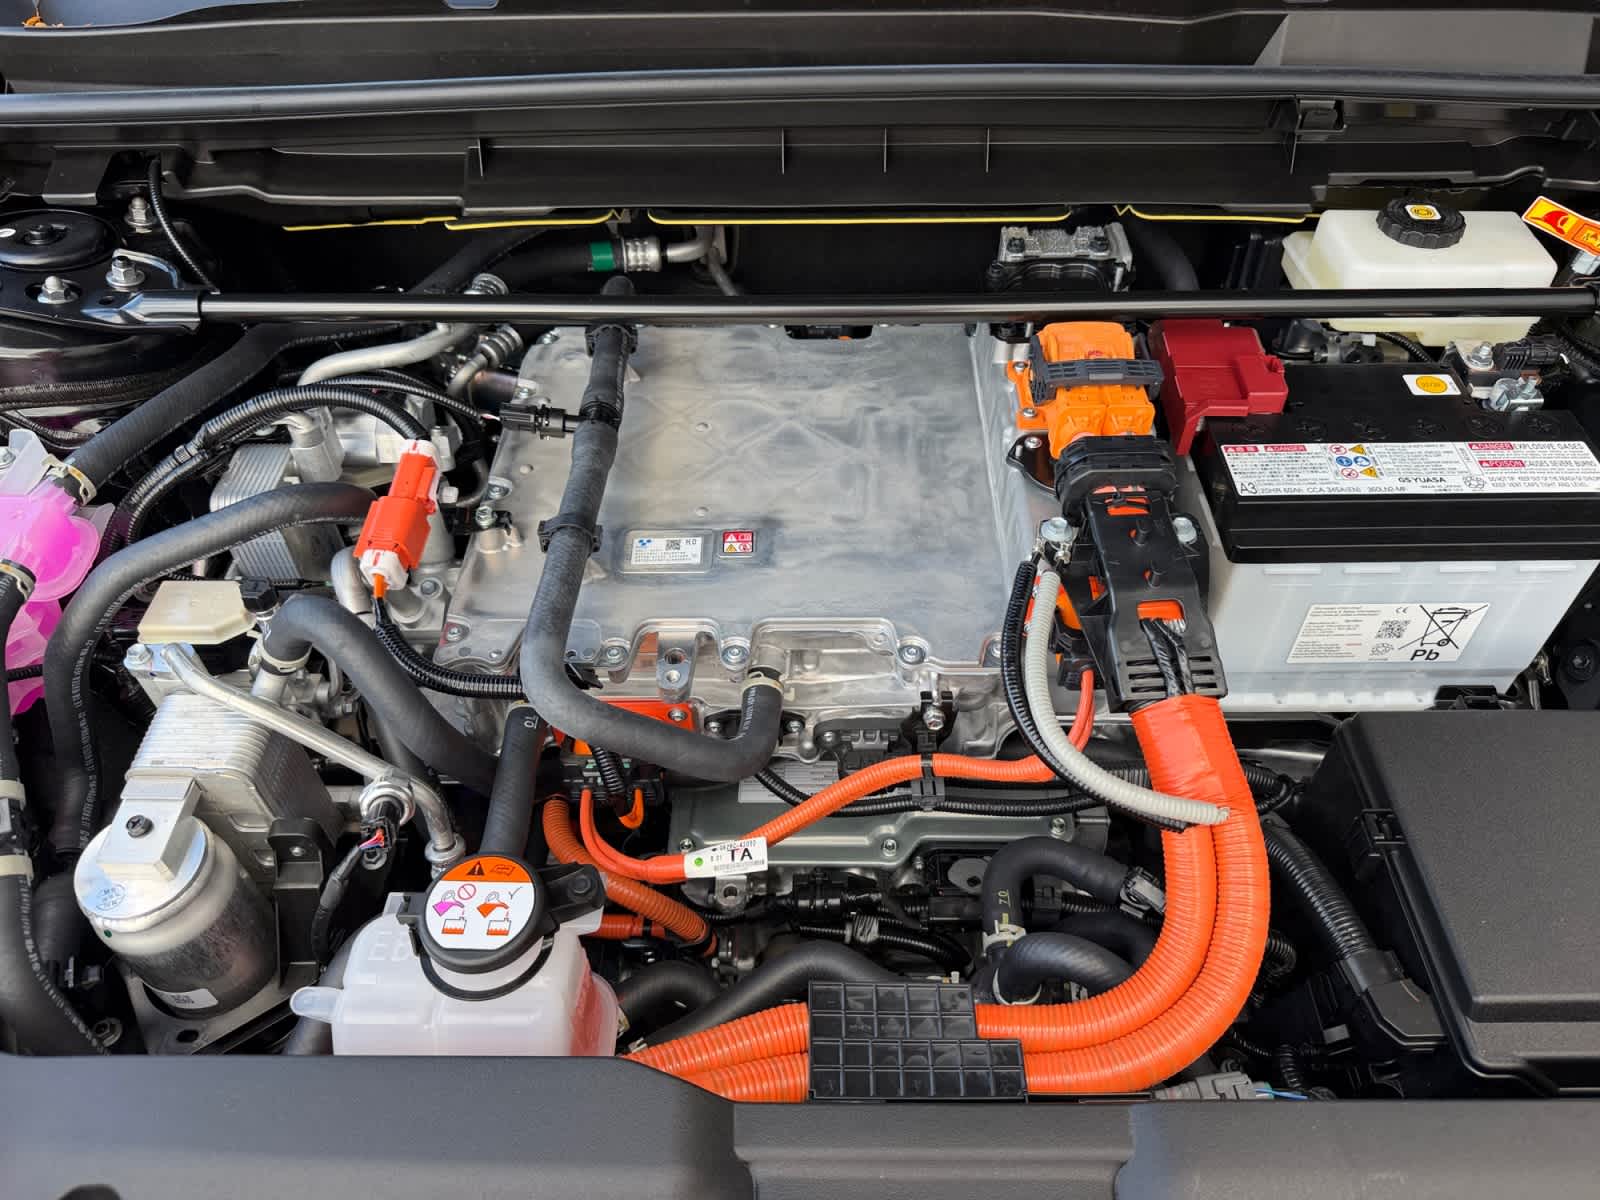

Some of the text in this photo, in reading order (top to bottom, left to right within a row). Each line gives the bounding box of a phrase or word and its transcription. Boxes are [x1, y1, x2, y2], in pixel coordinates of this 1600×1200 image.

[1240, 482, 1257, 495] A3
[1409, 649, 1440, 662] Pb
[728, 847, 753, 862] TA
